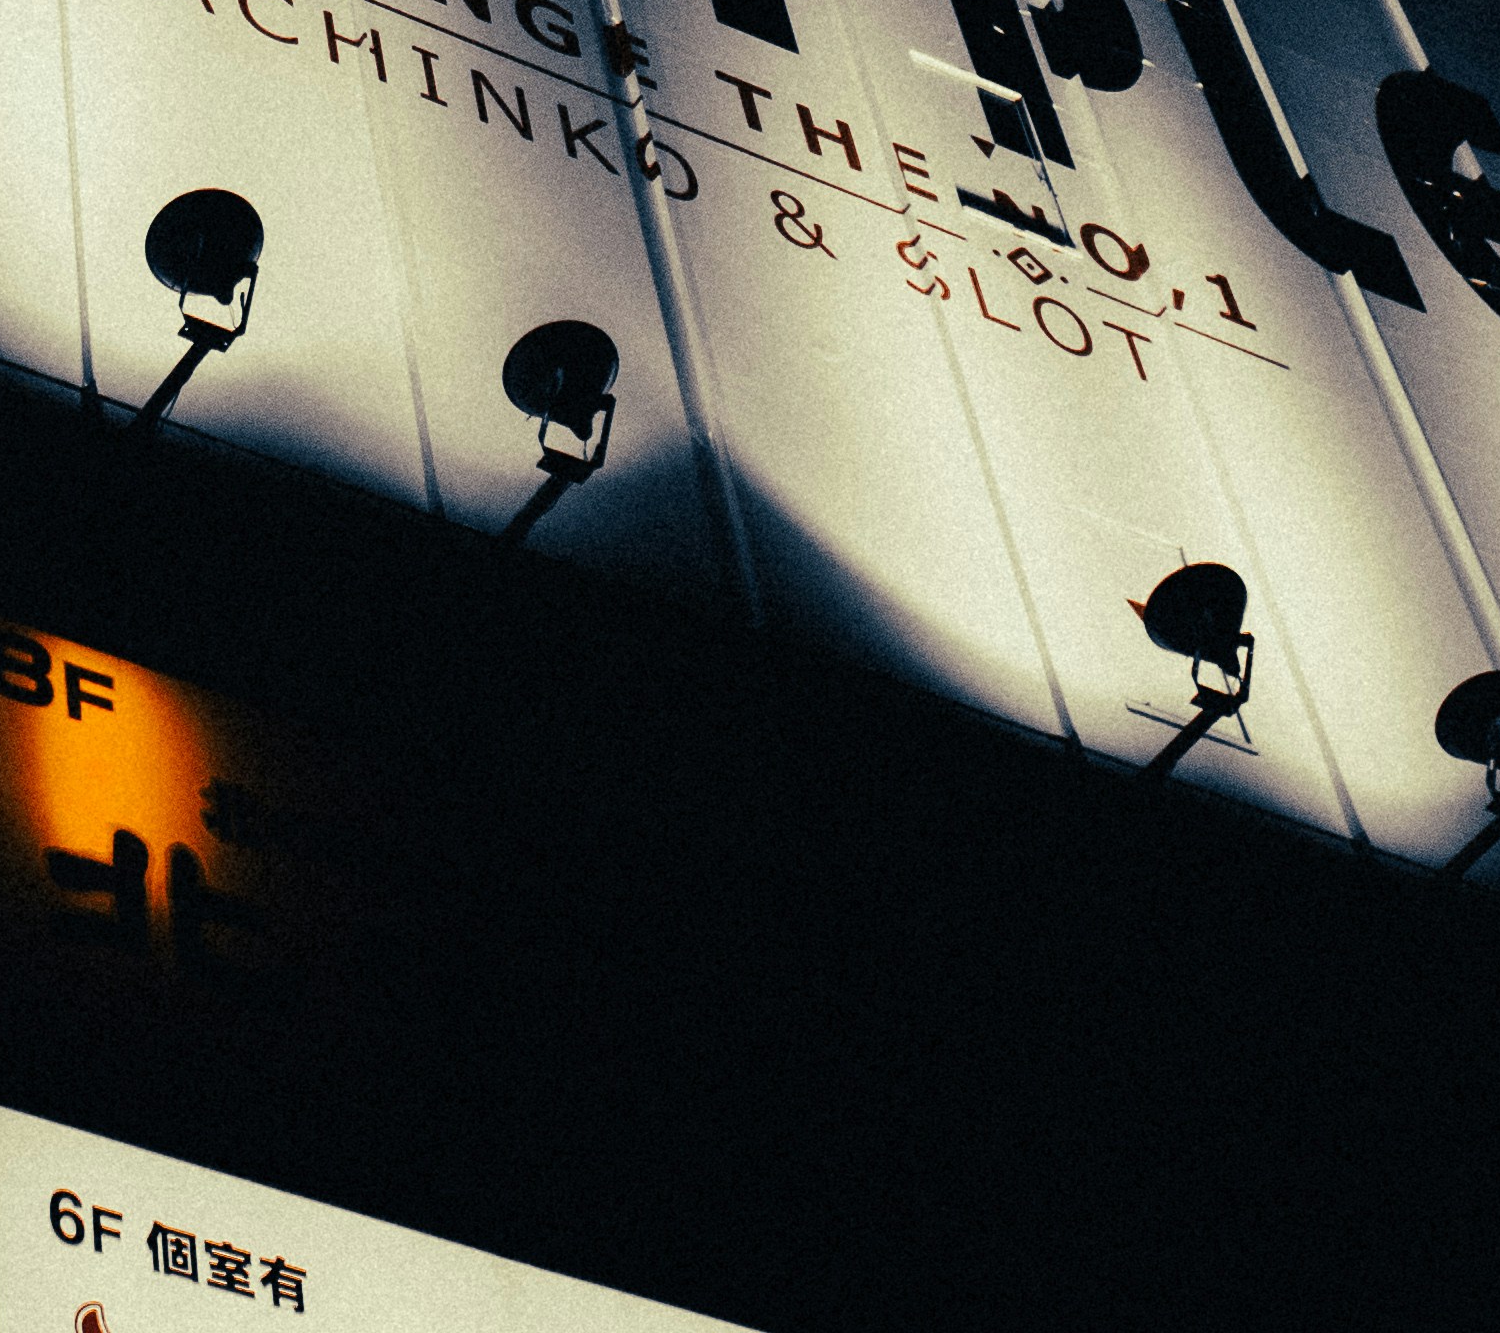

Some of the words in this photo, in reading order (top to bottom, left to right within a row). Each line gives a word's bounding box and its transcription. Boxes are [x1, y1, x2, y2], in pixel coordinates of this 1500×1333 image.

[715, 70, 939, 202] THE
[770, 189, 839, 261] &
[896, 234, 1152, 382] SLOT
[49, 1188, 124, 1253] 6F
[146, 1220, 308, 1314] 個室有
